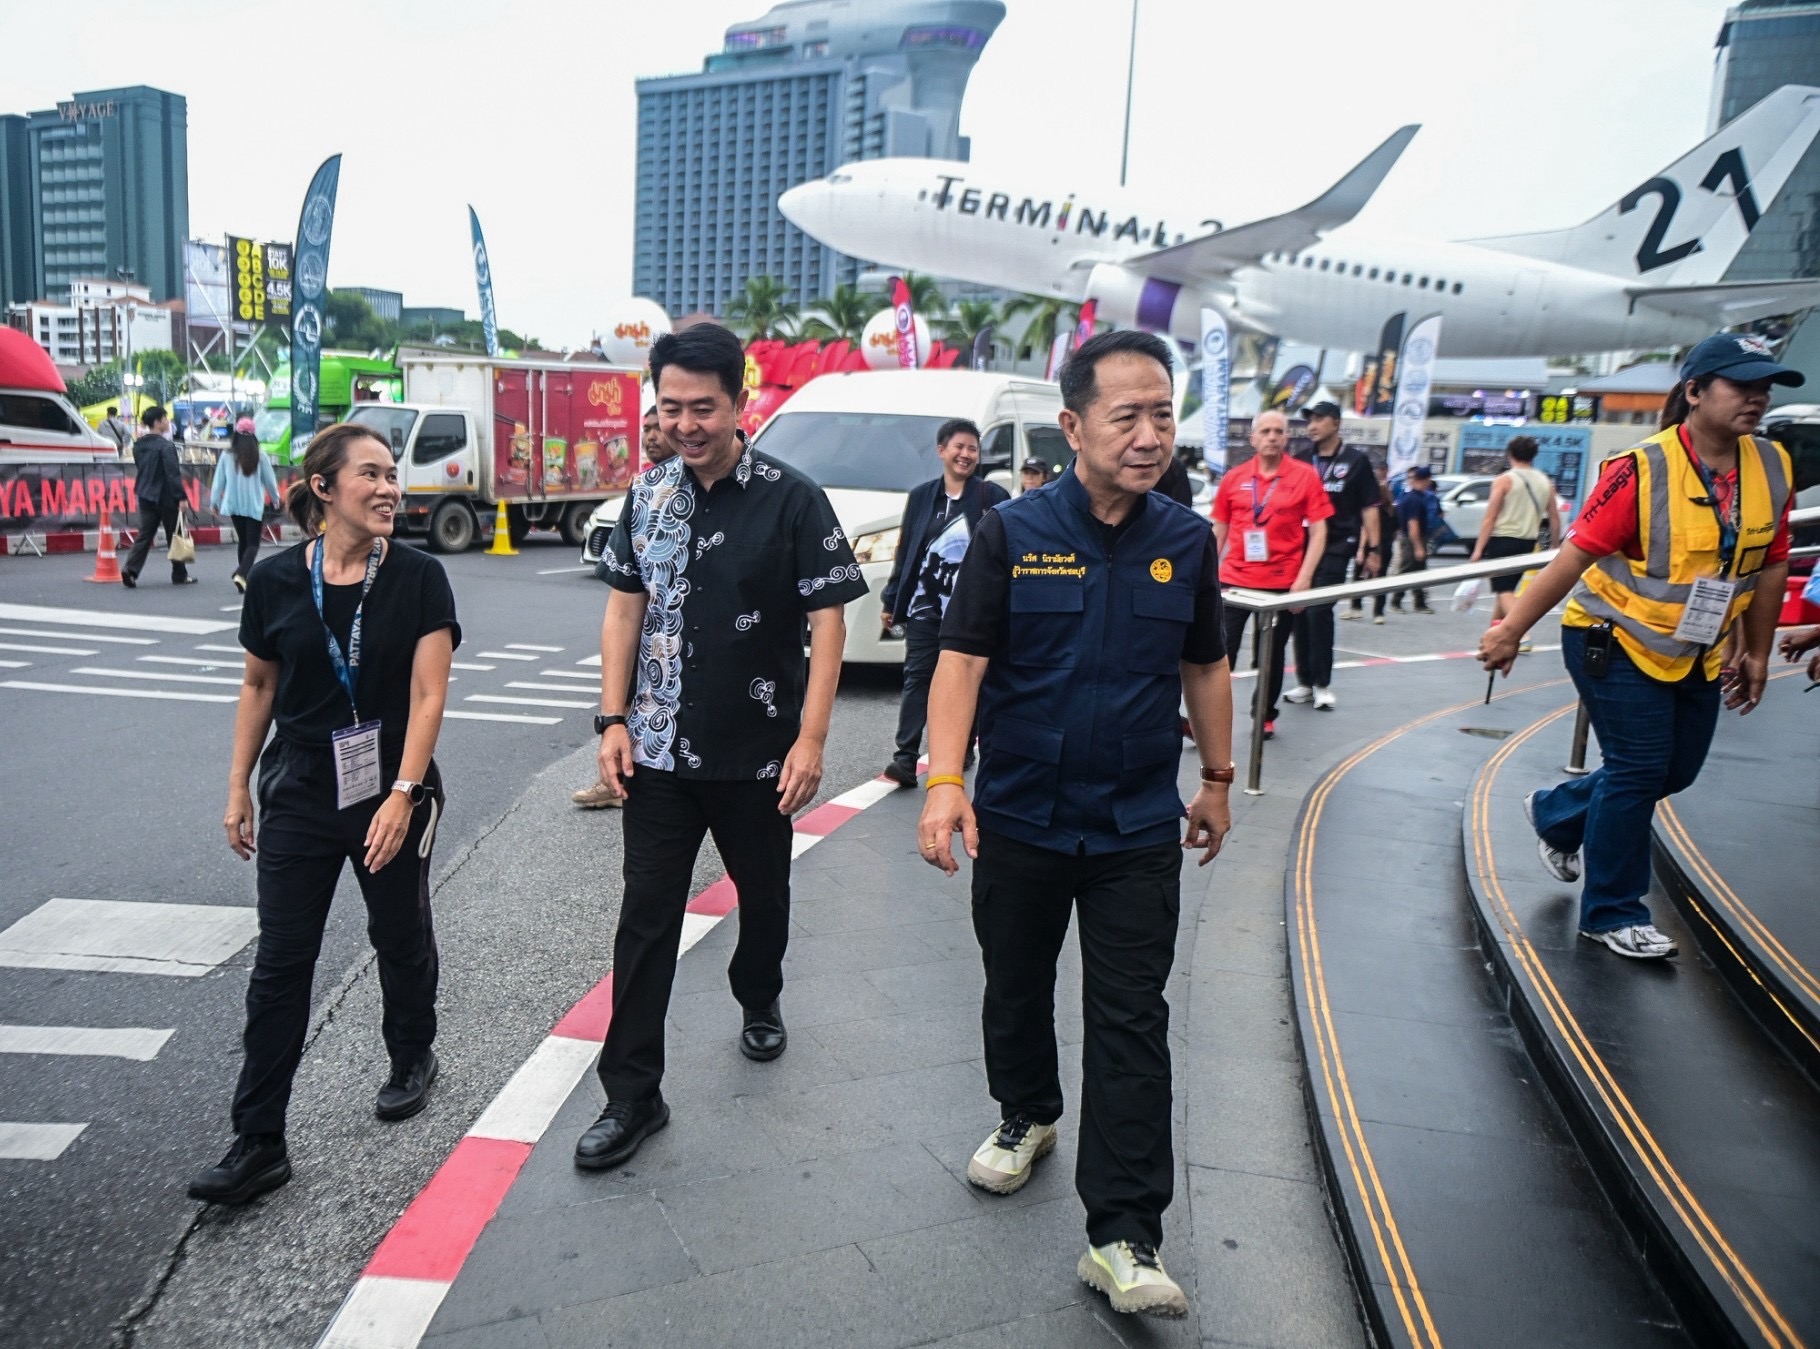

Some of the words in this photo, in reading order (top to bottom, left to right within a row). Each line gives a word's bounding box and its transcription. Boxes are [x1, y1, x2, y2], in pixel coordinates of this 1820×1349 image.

[1618, 146, 1761, 273] 21
[40, 478, 200, 517] MARATN
[349, 617, 362, 667] PATTAYA
